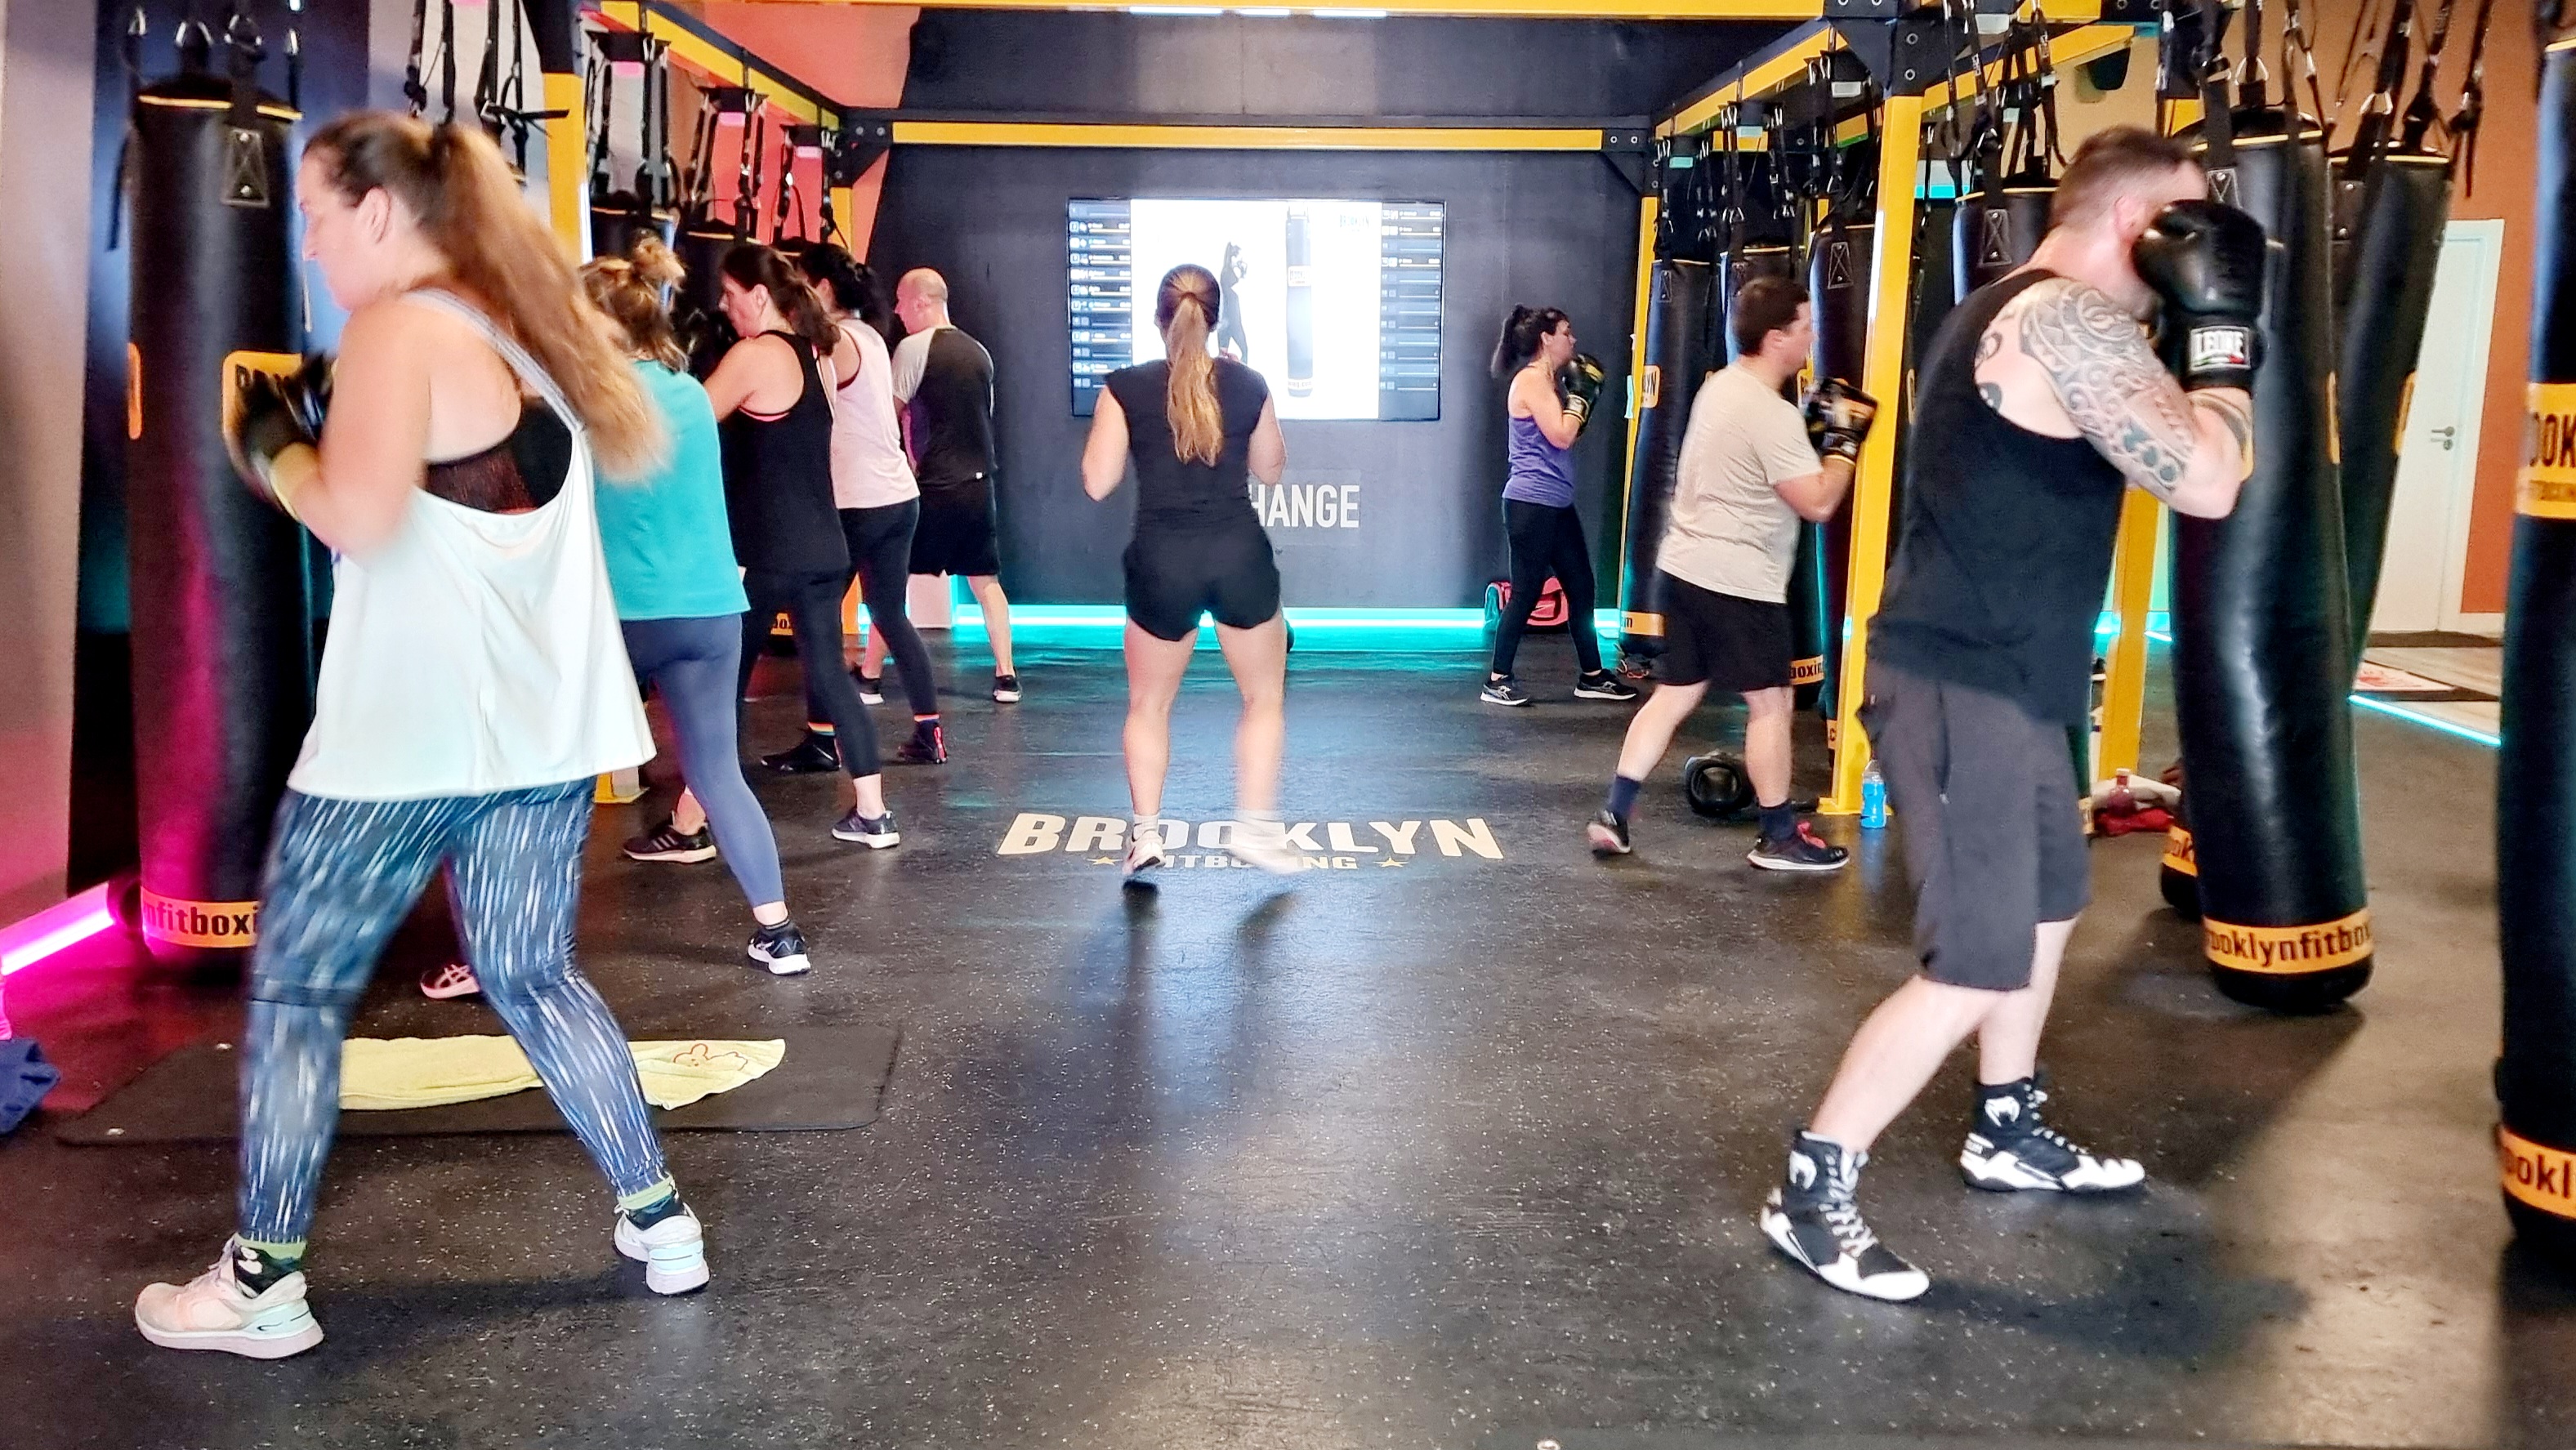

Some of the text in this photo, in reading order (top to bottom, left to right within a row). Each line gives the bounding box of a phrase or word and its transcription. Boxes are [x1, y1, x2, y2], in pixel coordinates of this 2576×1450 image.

[1248, 484, 1359, 528] HANGE
[997, 813, 1504, 859] BROOKLYN
[1163, 854, 1359, 869] ITBNG
[2206, 921, 2369, 967] ooklynfitbo
[2502, 1146, 2570, 1199] okl
